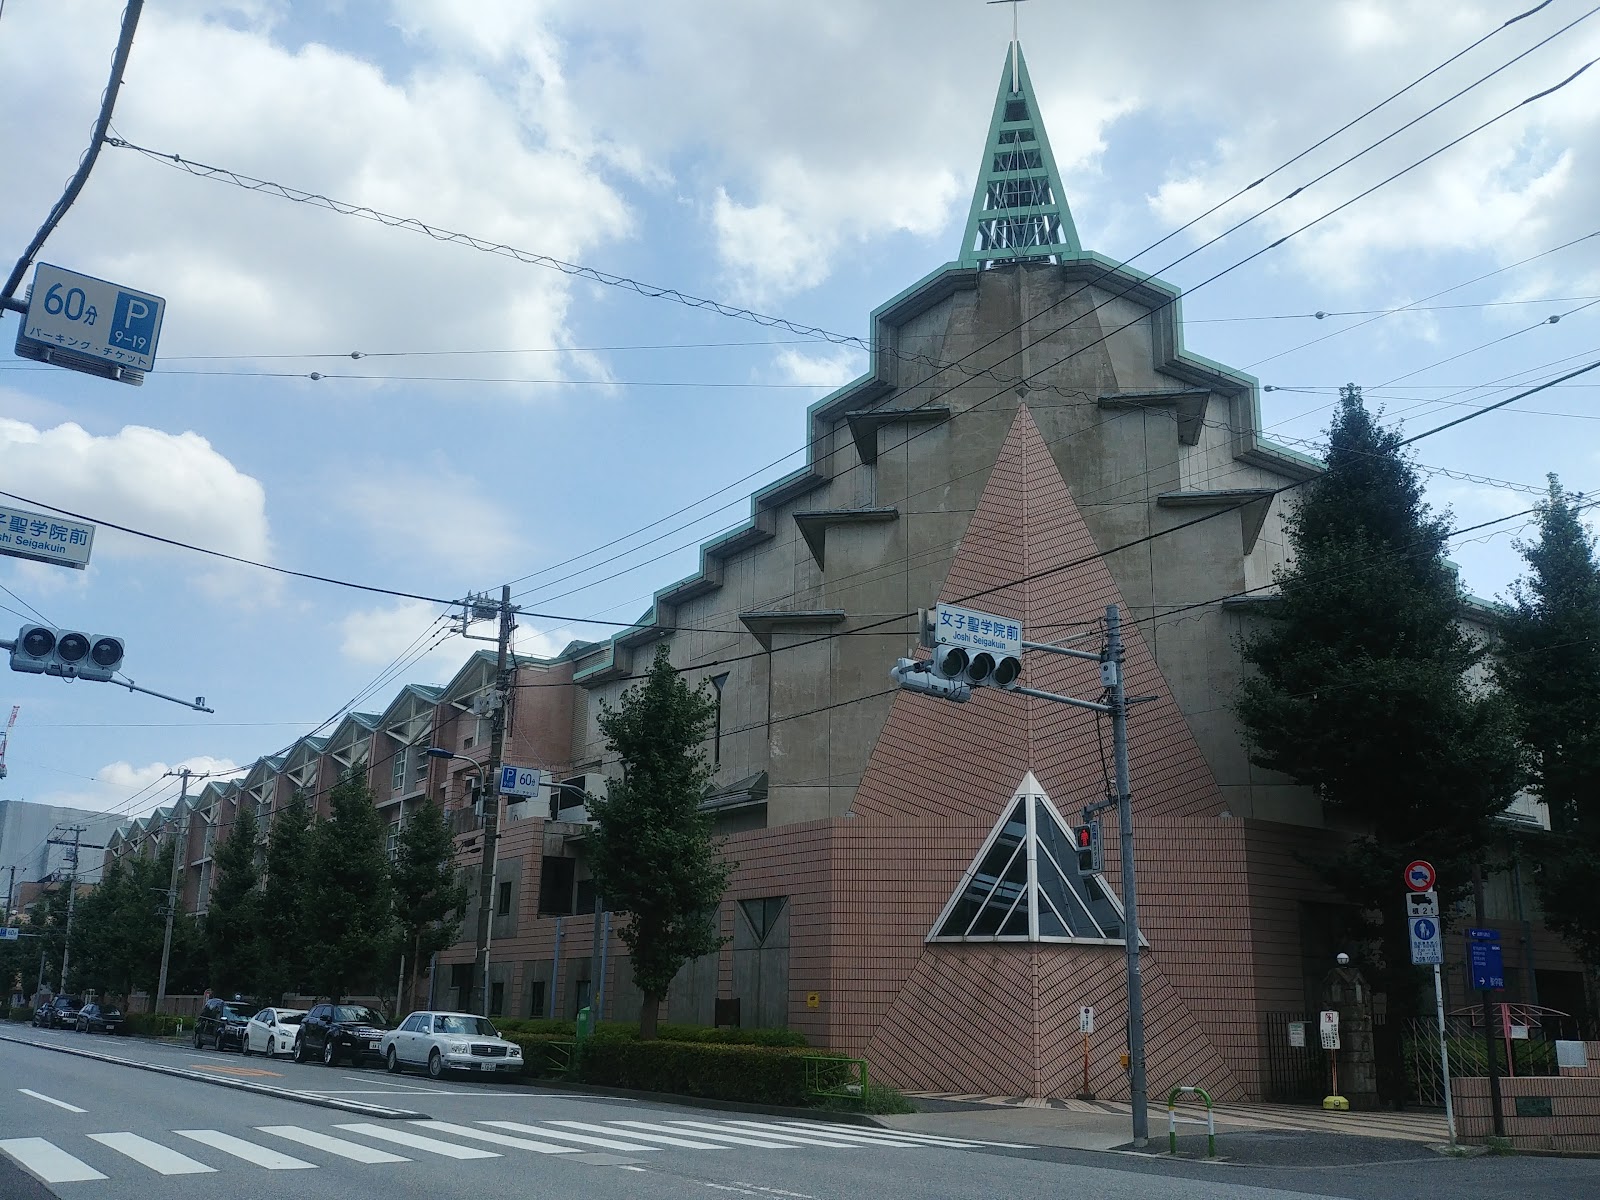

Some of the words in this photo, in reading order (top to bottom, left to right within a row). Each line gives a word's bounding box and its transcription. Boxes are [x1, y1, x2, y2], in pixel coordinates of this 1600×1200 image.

[43, 282, 98, 326] 60分
[124, 299, 149, 329] P
[114, 330, 147, 350] 9-19
[15, 535, 66, 554] Seigakuin
[940, 610, 1019, 642] 女子聖学院前
[952, 630, 971, 643] Joshi
[973, 634, 1006, 650] Seigakuin
[507, 770, 515, 780] P
